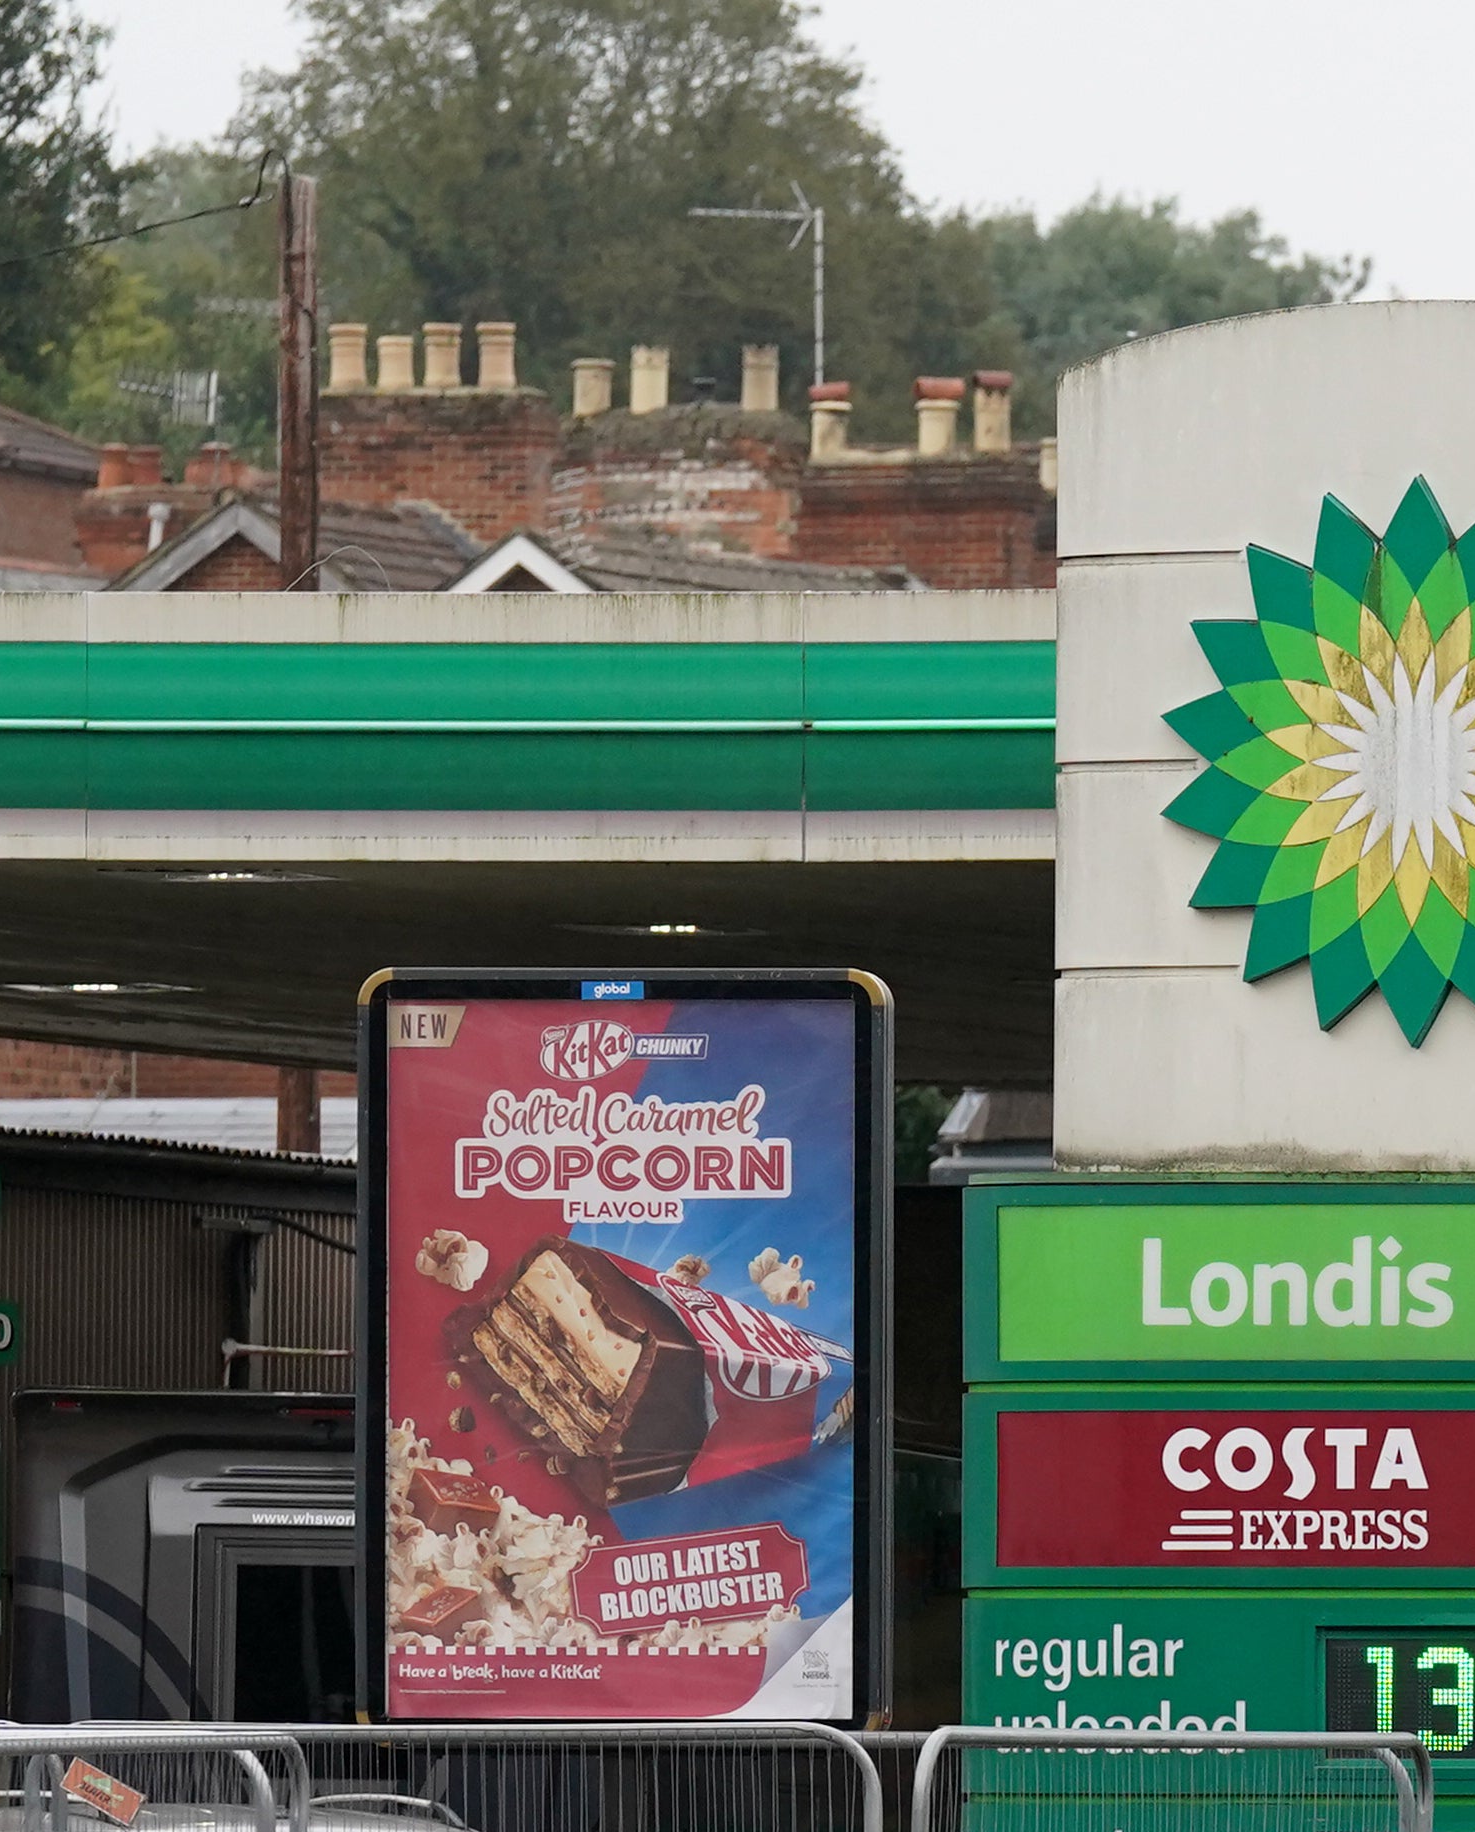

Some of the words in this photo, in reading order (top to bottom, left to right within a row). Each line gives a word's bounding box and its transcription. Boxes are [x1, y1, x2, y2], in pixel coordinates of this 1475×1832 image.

[593, 982, 631, 998] global
[399, 1013, 449, 1041] NEW
[552, 1021, 630, 1080] KitKat
[635, 1038, 703, 1055] CHUNKY
[488, 1090, 600, 1138] Salted
[601, 1090, 758, 1136] Caramel
[461, 1144, 786, 1192] POPCORN
[567, 1201, 680, 1219] FLAVOUR
[1141, 1234, 1455, 1328] Londis
[1161, 1427, 1430, 1500] COSTA
[1239, 1509, 1430, 1552] EXPRESS
[613, 1551, 667, 1586] OUR
[671, 1539, 762, 1579] LATEST
[599, 1571, 785, 1623] BLOCKBUSTER
[398, 1663, 436, 1678] Have
[437, 1667, 448, 1678] a
[501, 1664, 536, 1679] have
[538, 1668, 549, 1679] a
[994, 1623, 1185, 1692] regular
